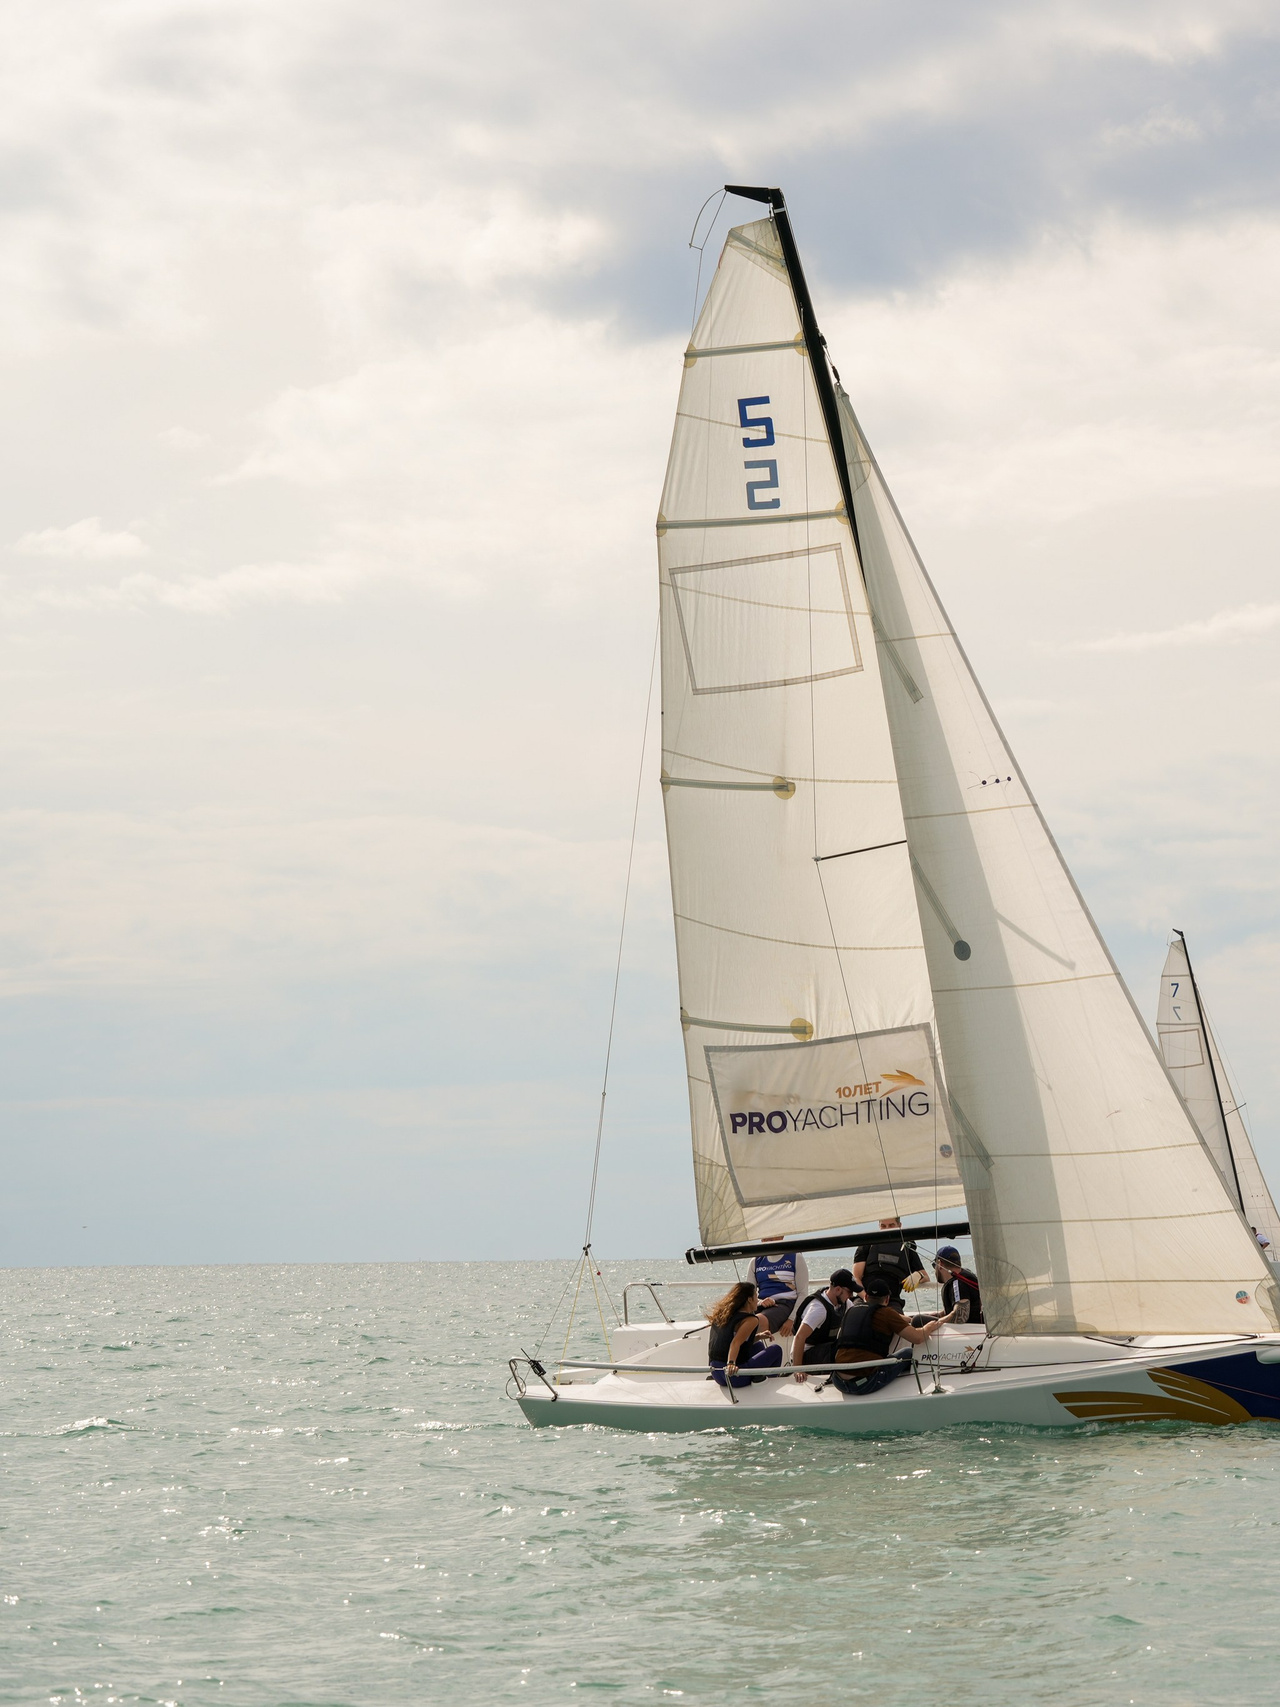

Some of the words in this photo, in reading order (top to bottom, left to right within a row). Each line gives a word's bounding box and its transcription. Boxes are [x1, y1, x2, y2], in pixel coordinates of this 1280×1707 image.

[737, 395, 776, 449] 5
[1170, 982, 1180, 998] 7
[729, 1091, 930, 1136] PROYACHTING
